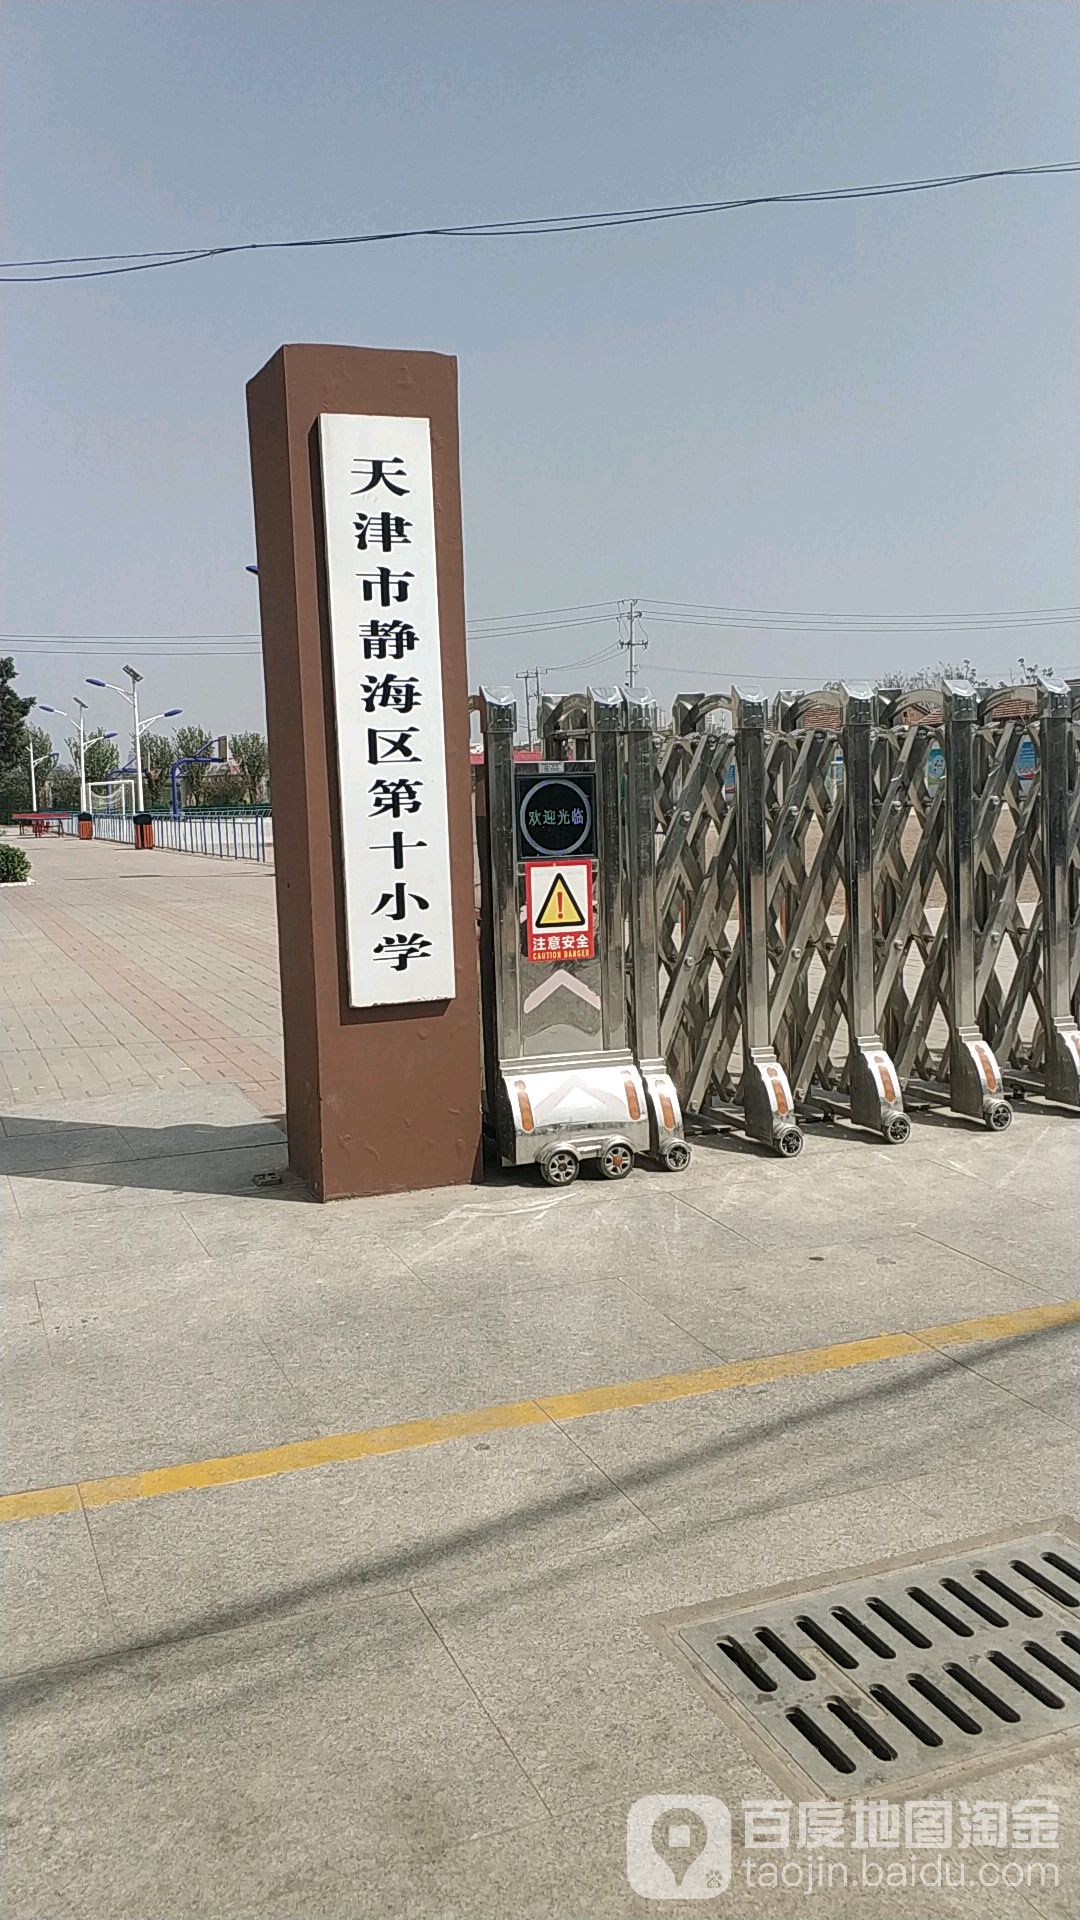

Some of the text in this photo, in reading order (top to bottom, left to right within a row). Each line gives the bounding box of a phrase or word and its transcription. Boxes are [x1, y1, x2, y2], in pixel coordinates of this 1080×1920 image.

[350, 456, 433, 971] 天津市静海区第十小学
[528, 807, 584, 826] 欢迎光临
[532, 934, 590, 951] 注意安全
[532, 949, 590, 960] CAUTION DANGER
